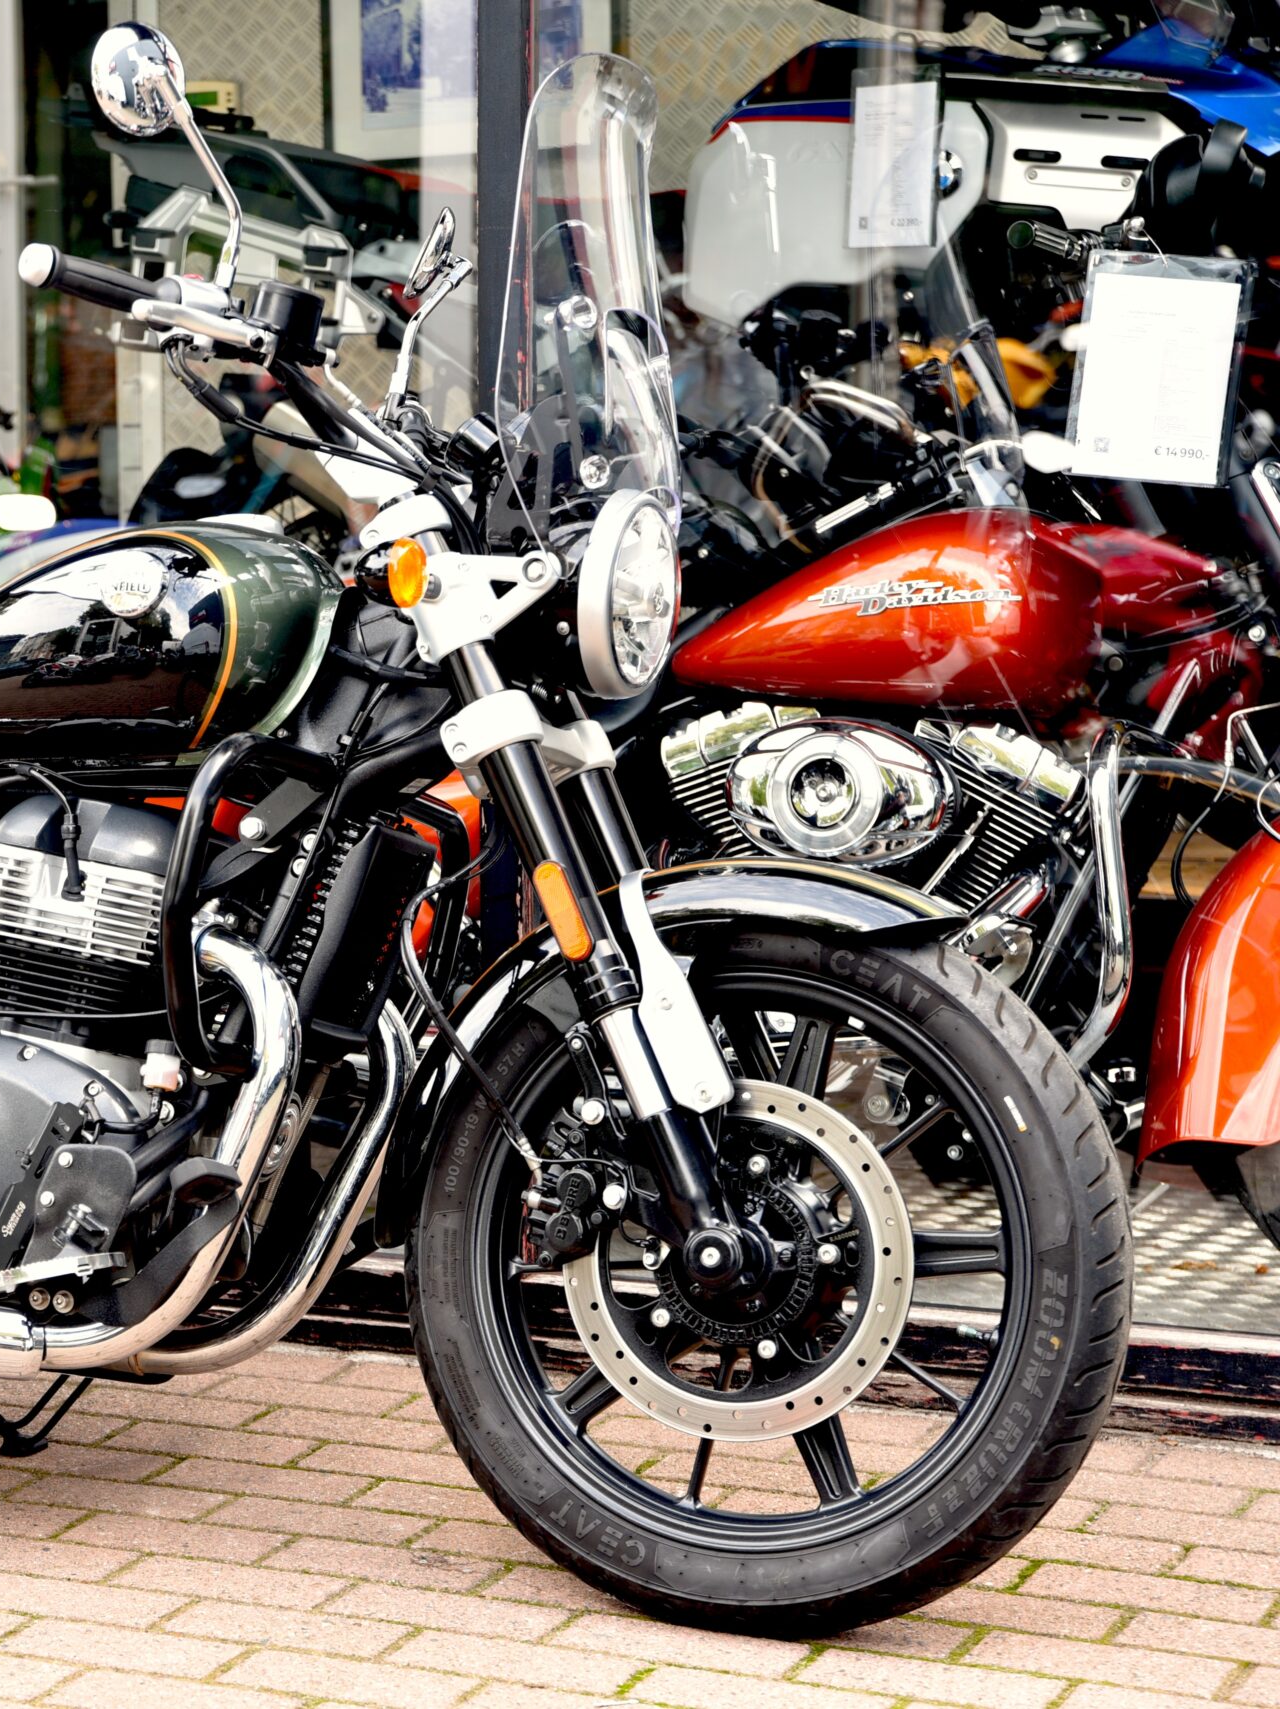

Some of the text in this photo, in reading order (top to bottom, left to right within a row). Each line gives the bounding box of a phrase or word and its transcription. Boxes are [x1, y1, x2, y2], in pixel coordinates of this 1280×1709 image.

[820, 580, 930, 606] Harley
[857, 586, 1020, 617] Davidson
[830, 949, 931, 1012] CEAT
[444, 1113, 479, 1193] 100/90-19
[559, 1178, 581, 1226] BYBRE
[1021, 1270, 1068, 1403] ZOOM
[549, 1500, 646, 1567] CEAT
